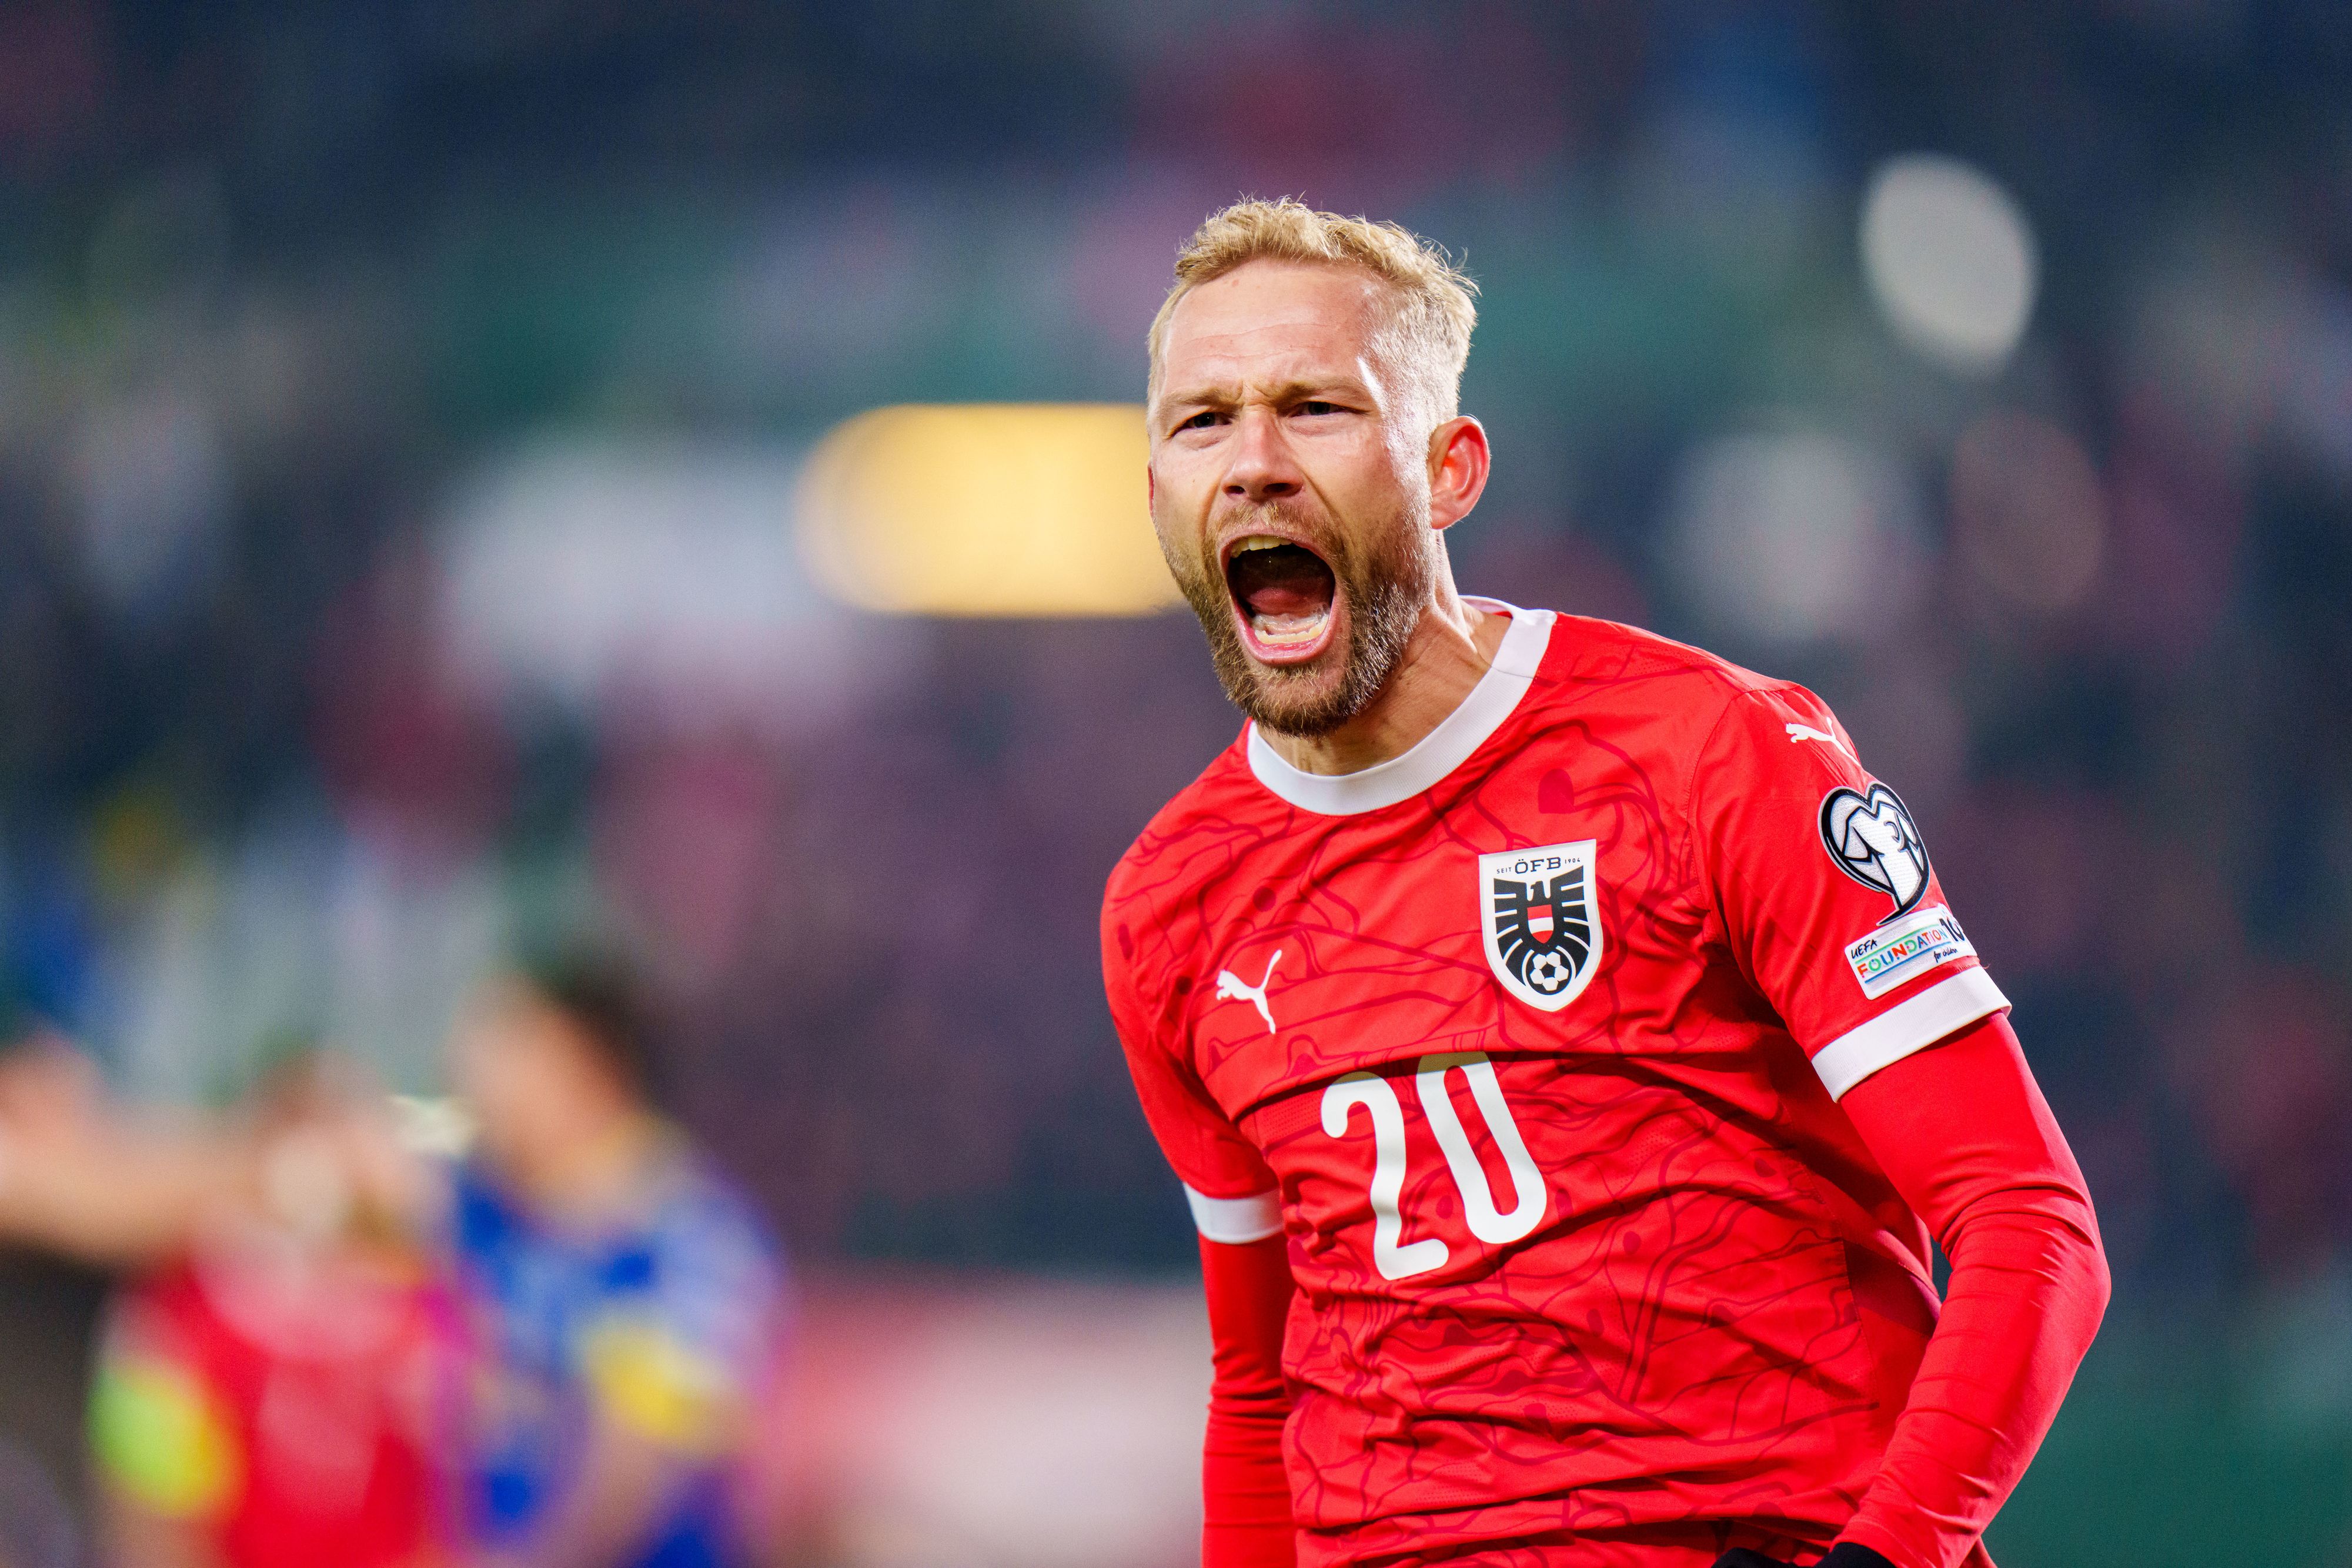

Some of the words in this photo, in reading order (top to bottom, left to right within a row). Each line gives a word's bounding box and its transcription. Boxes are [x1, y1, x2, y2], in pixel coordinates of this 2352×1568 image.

[1515, 857, 1561, 874] ÖFB
[1851, 939, 1877, 959] UEFA
[1857, 929, 1949, 978] FOUNDATION
[1321, 1051, 1547, 1281] 20
